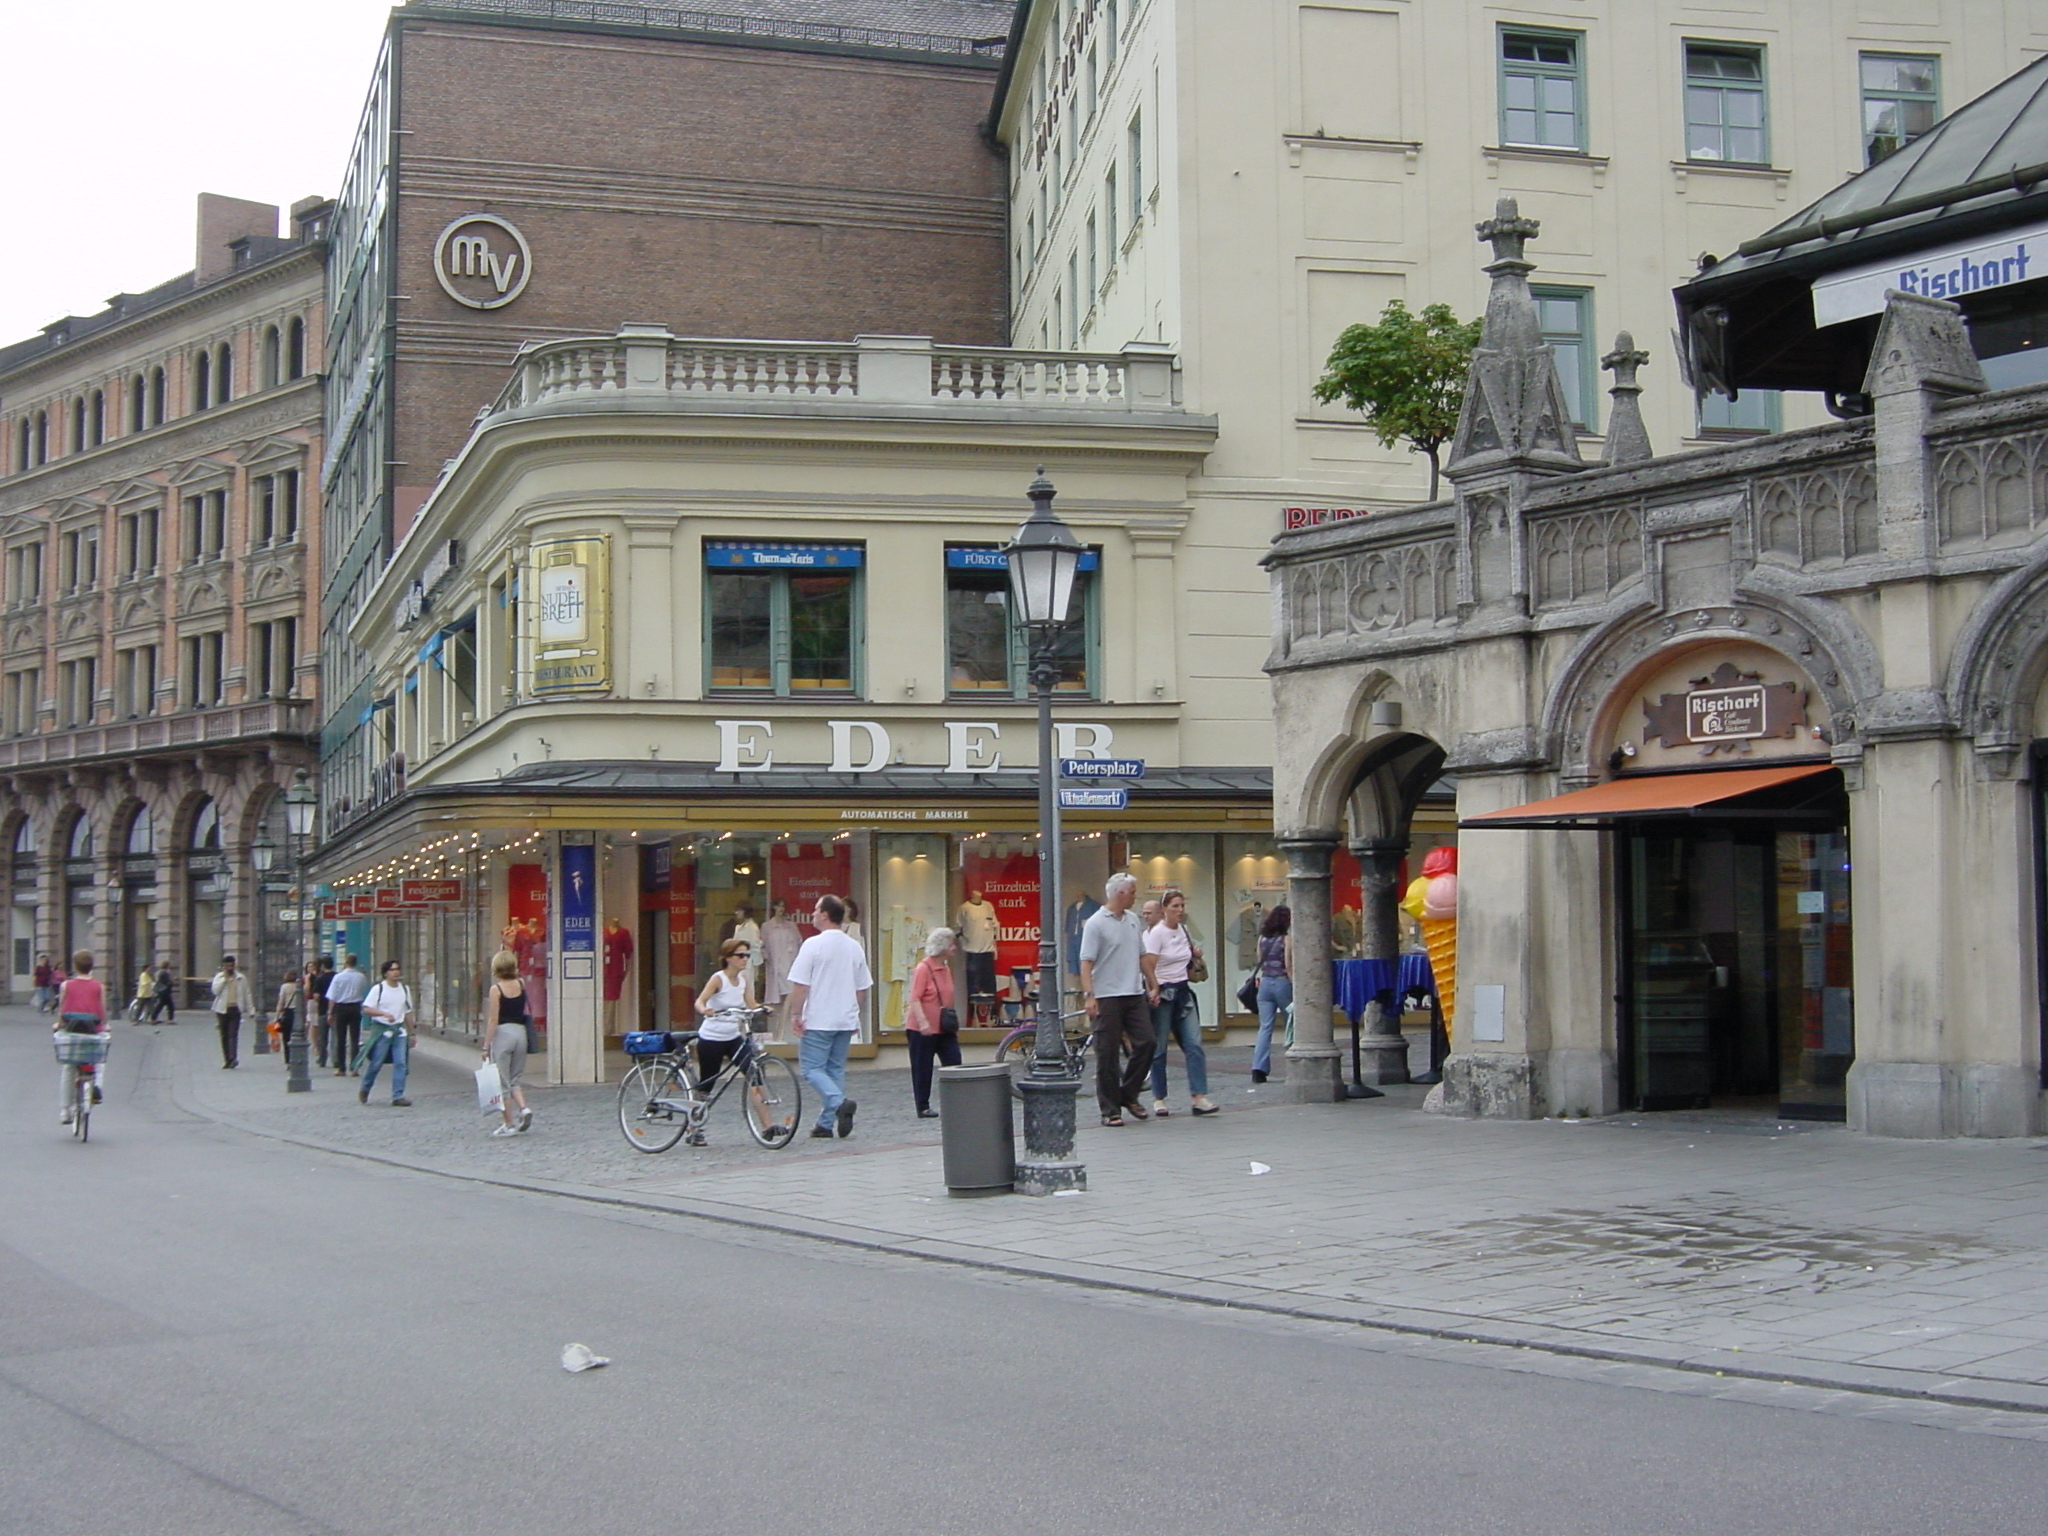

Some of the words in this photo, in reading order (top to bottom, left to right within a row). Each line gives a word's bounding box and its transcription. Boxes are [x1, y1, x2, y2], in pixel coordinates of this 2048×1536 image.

[1900, 243, 2031, 299] Rischart
[964, 553, 997, 565] FÜRST
[541, 590, 582, 606] NUDEL
[541, 601, 584, 622] BRETT
[1692, 692, 1760, 714] Rischart
[714, 720, 1115, 774] EDER
[1068, 760, 1138, 777] Petersplatz
[841, 810, 917, 820] AUTOMATISCHE
[925, 810, 969, 820] MARKISE
[985, 881, 1041, 892] Einzelteile
[998, 896, 1027, 908] stark
[565, 917, 591, 928] EDER
